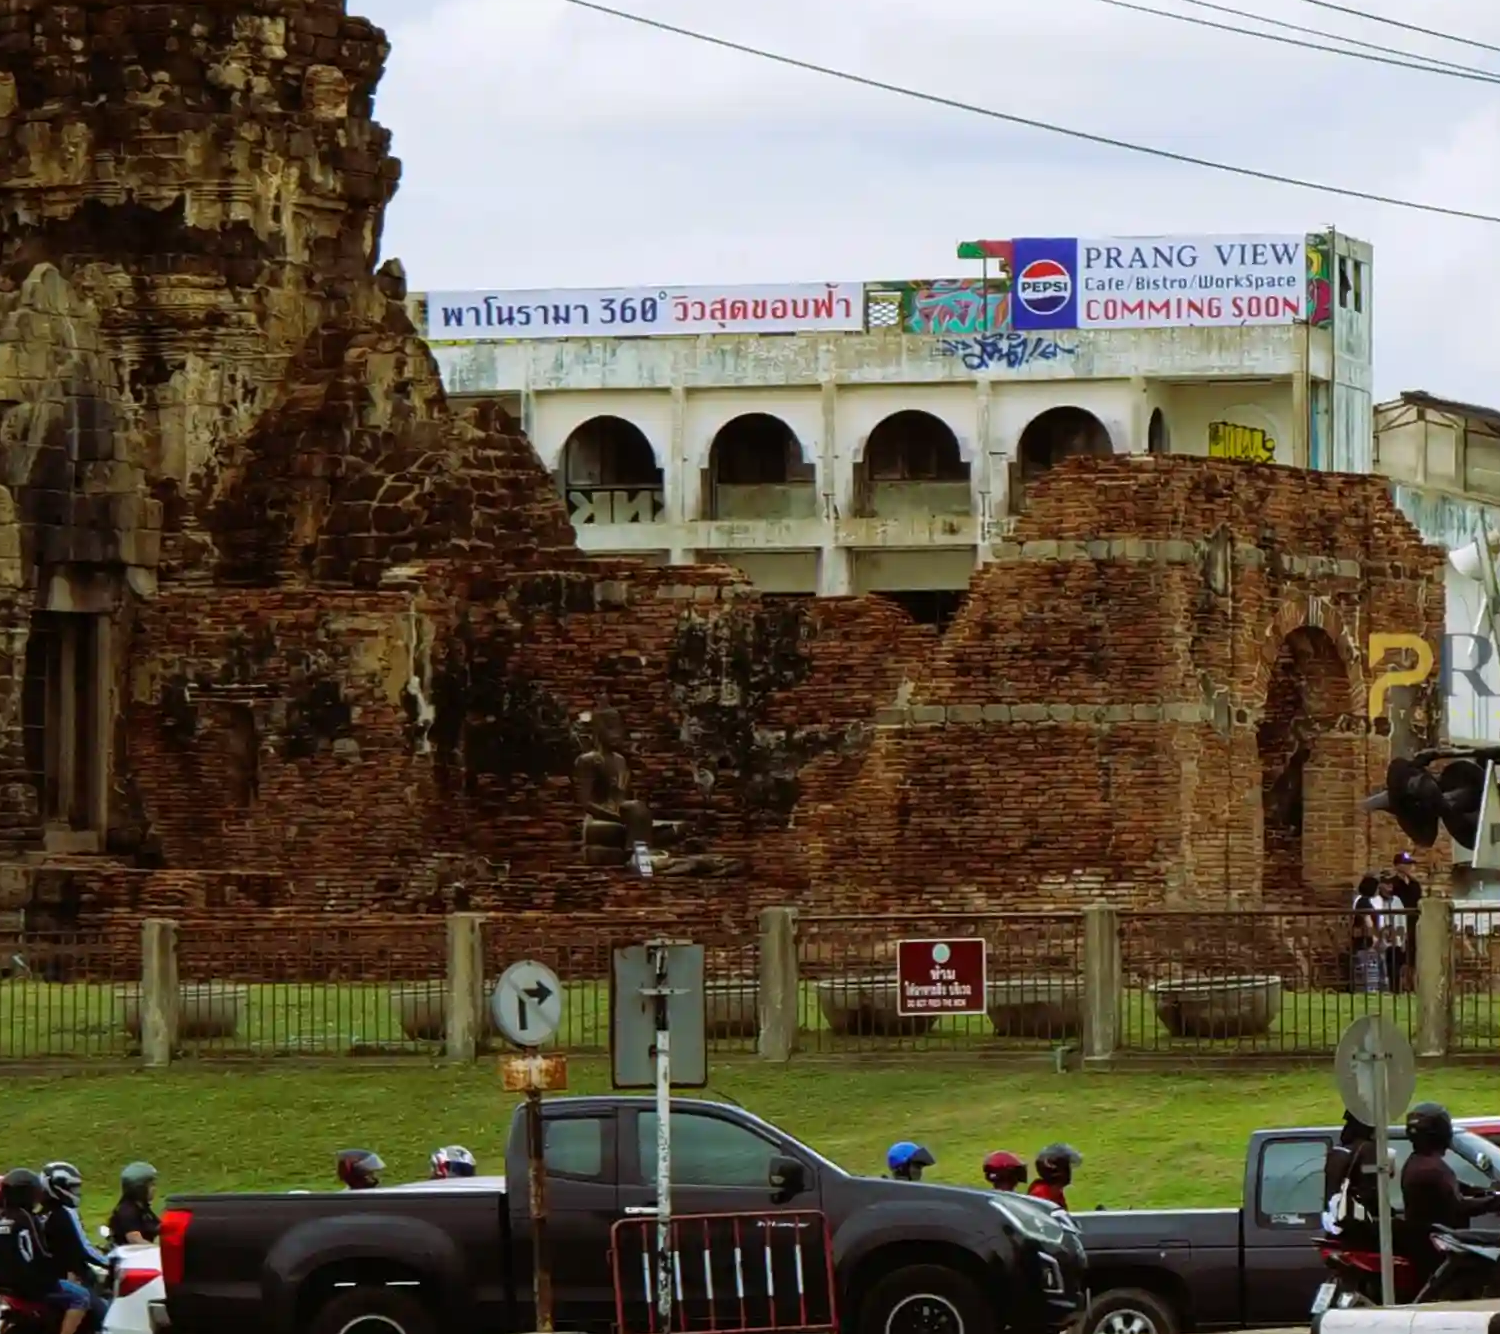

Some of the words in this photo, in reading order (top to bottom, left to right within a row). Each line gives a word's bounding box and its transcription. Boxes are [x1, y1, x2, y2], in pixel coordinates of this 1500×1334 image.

[1084, 244, 1199, 269] PRANG
[1217, 241, 1301, 267] VIEW
[1020, 279, 1069, 294] PEPSI
[441, 296, 590, 328] พาโนรามา
[671, 283, 853, 330] วิวสุดขอบฟ้า
[1085, 296, 1222, 322] COMMING
[1231, 295, 1301, 319] SOON
